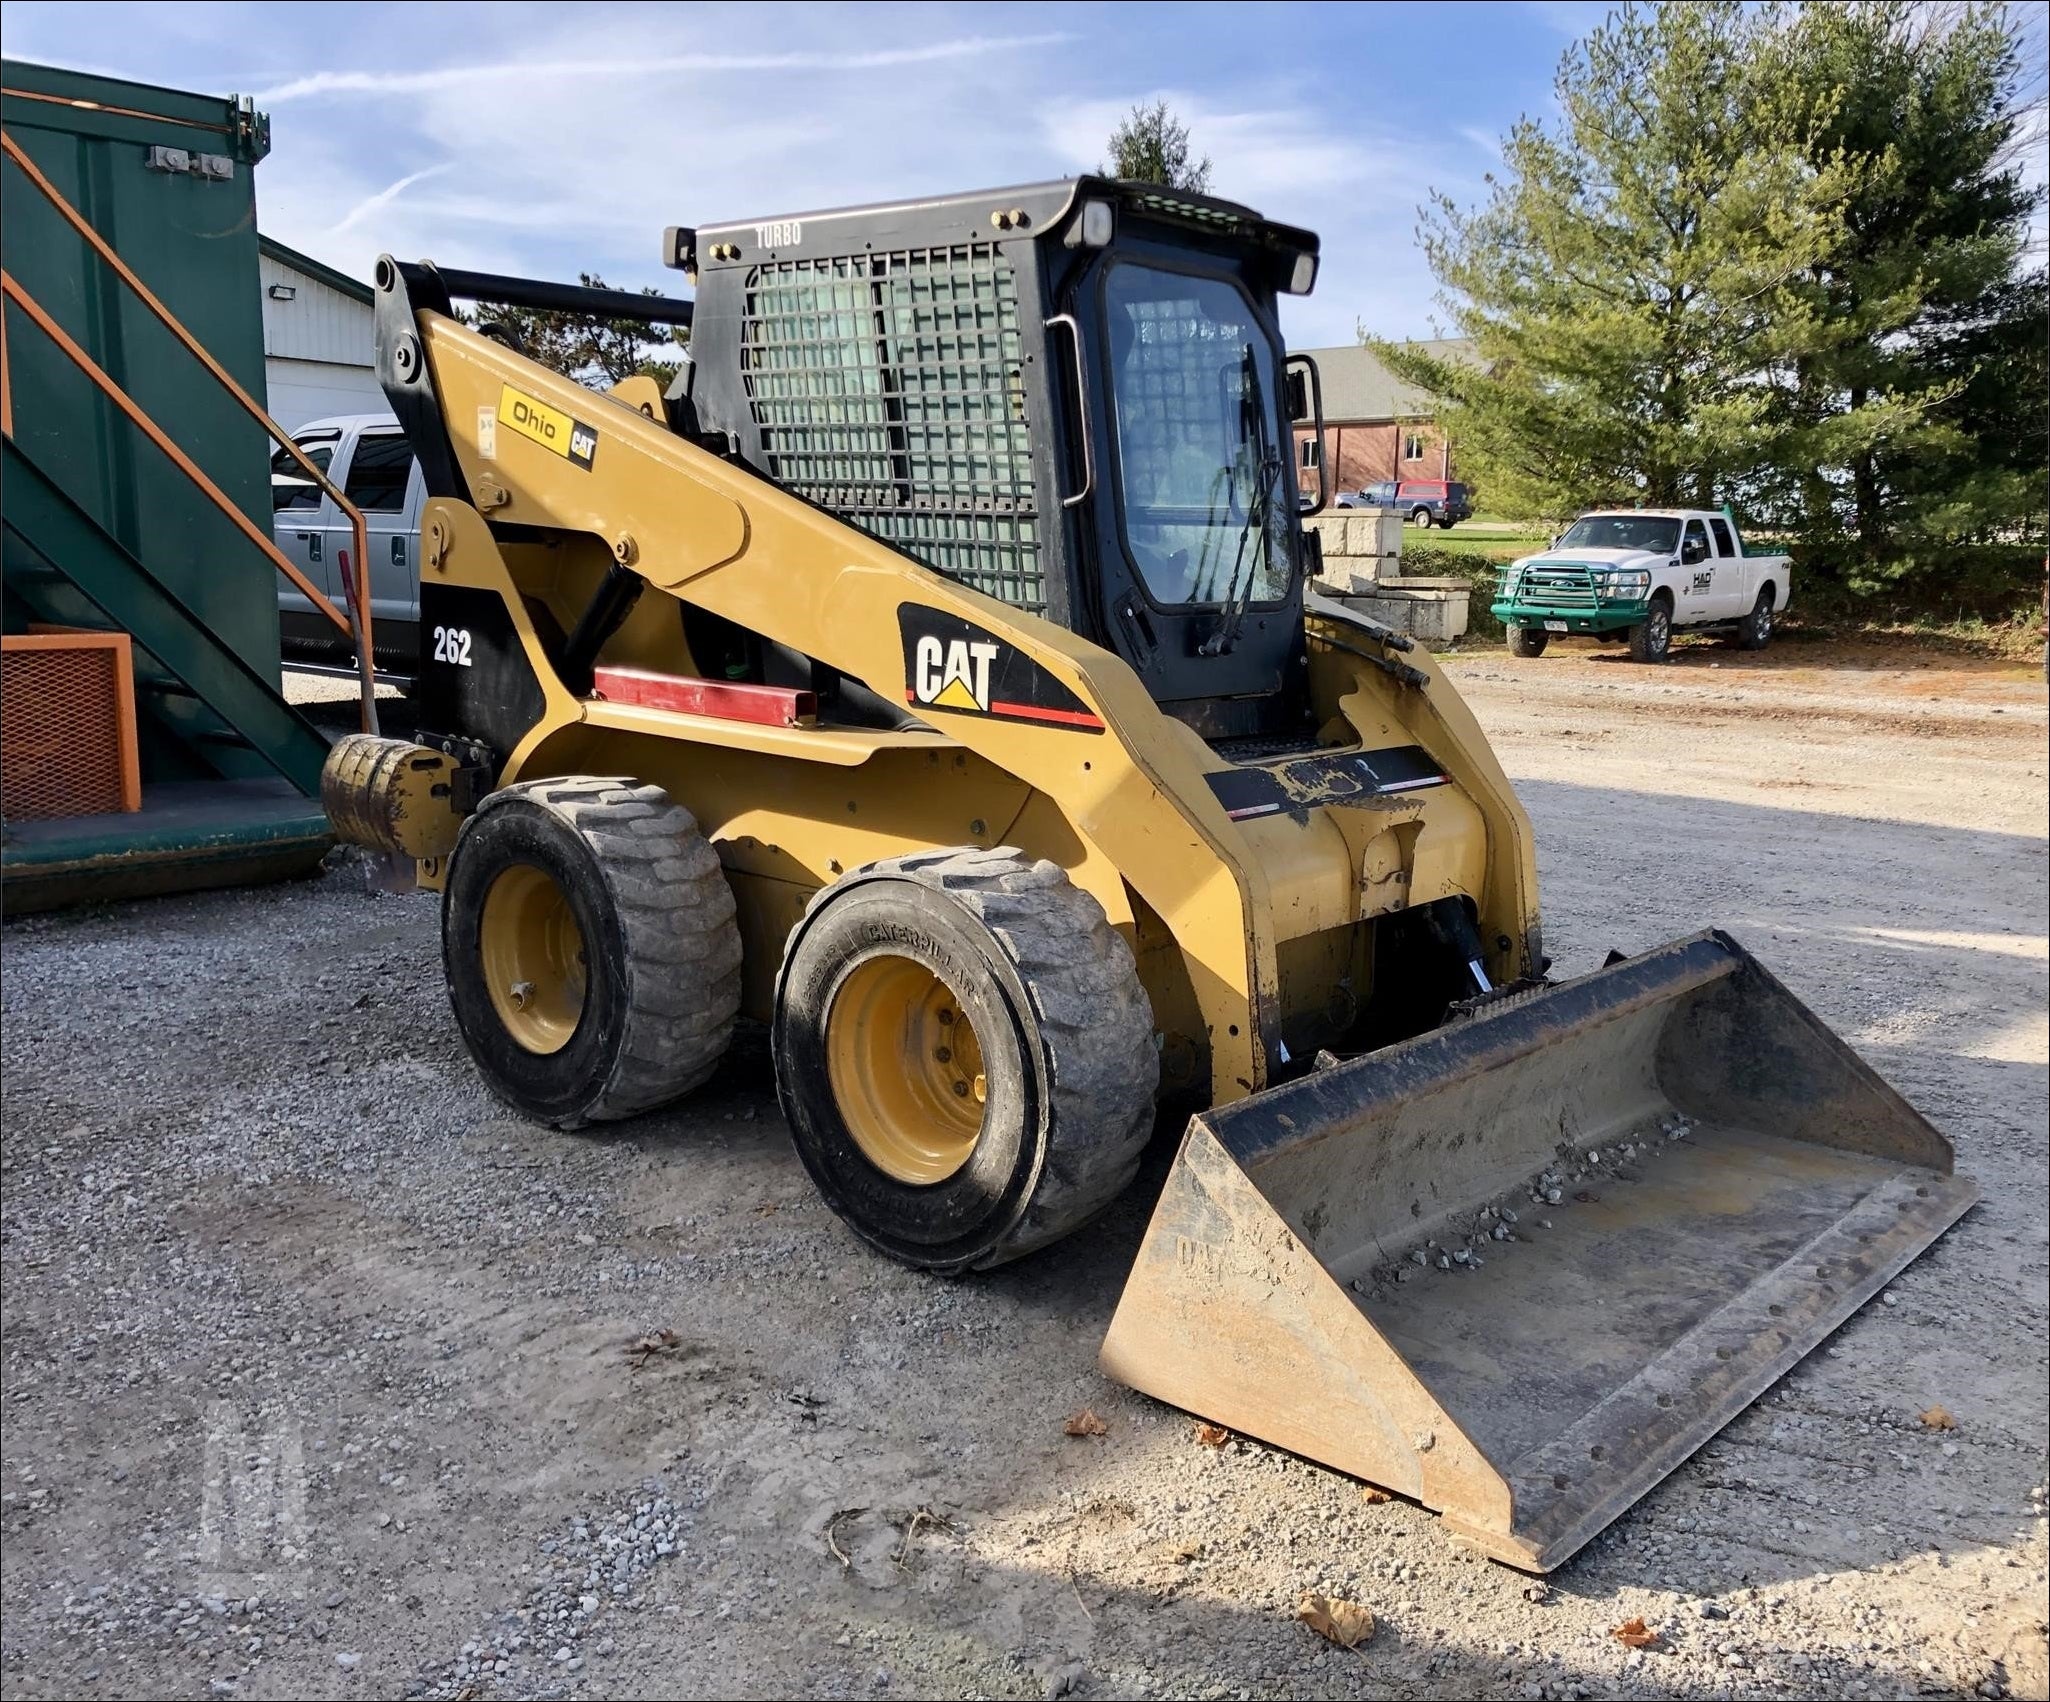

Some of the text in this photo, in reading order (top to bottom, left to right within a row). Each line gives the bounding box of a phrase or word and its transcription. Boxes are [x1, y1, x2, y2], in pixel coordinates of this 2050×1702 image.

[755, 222, 801, 249] TURBO
[513, 401, 597, 461] Ohio CAT
[433, 626, 472, 667] 262
[916, 636, 998, 712] CAT
